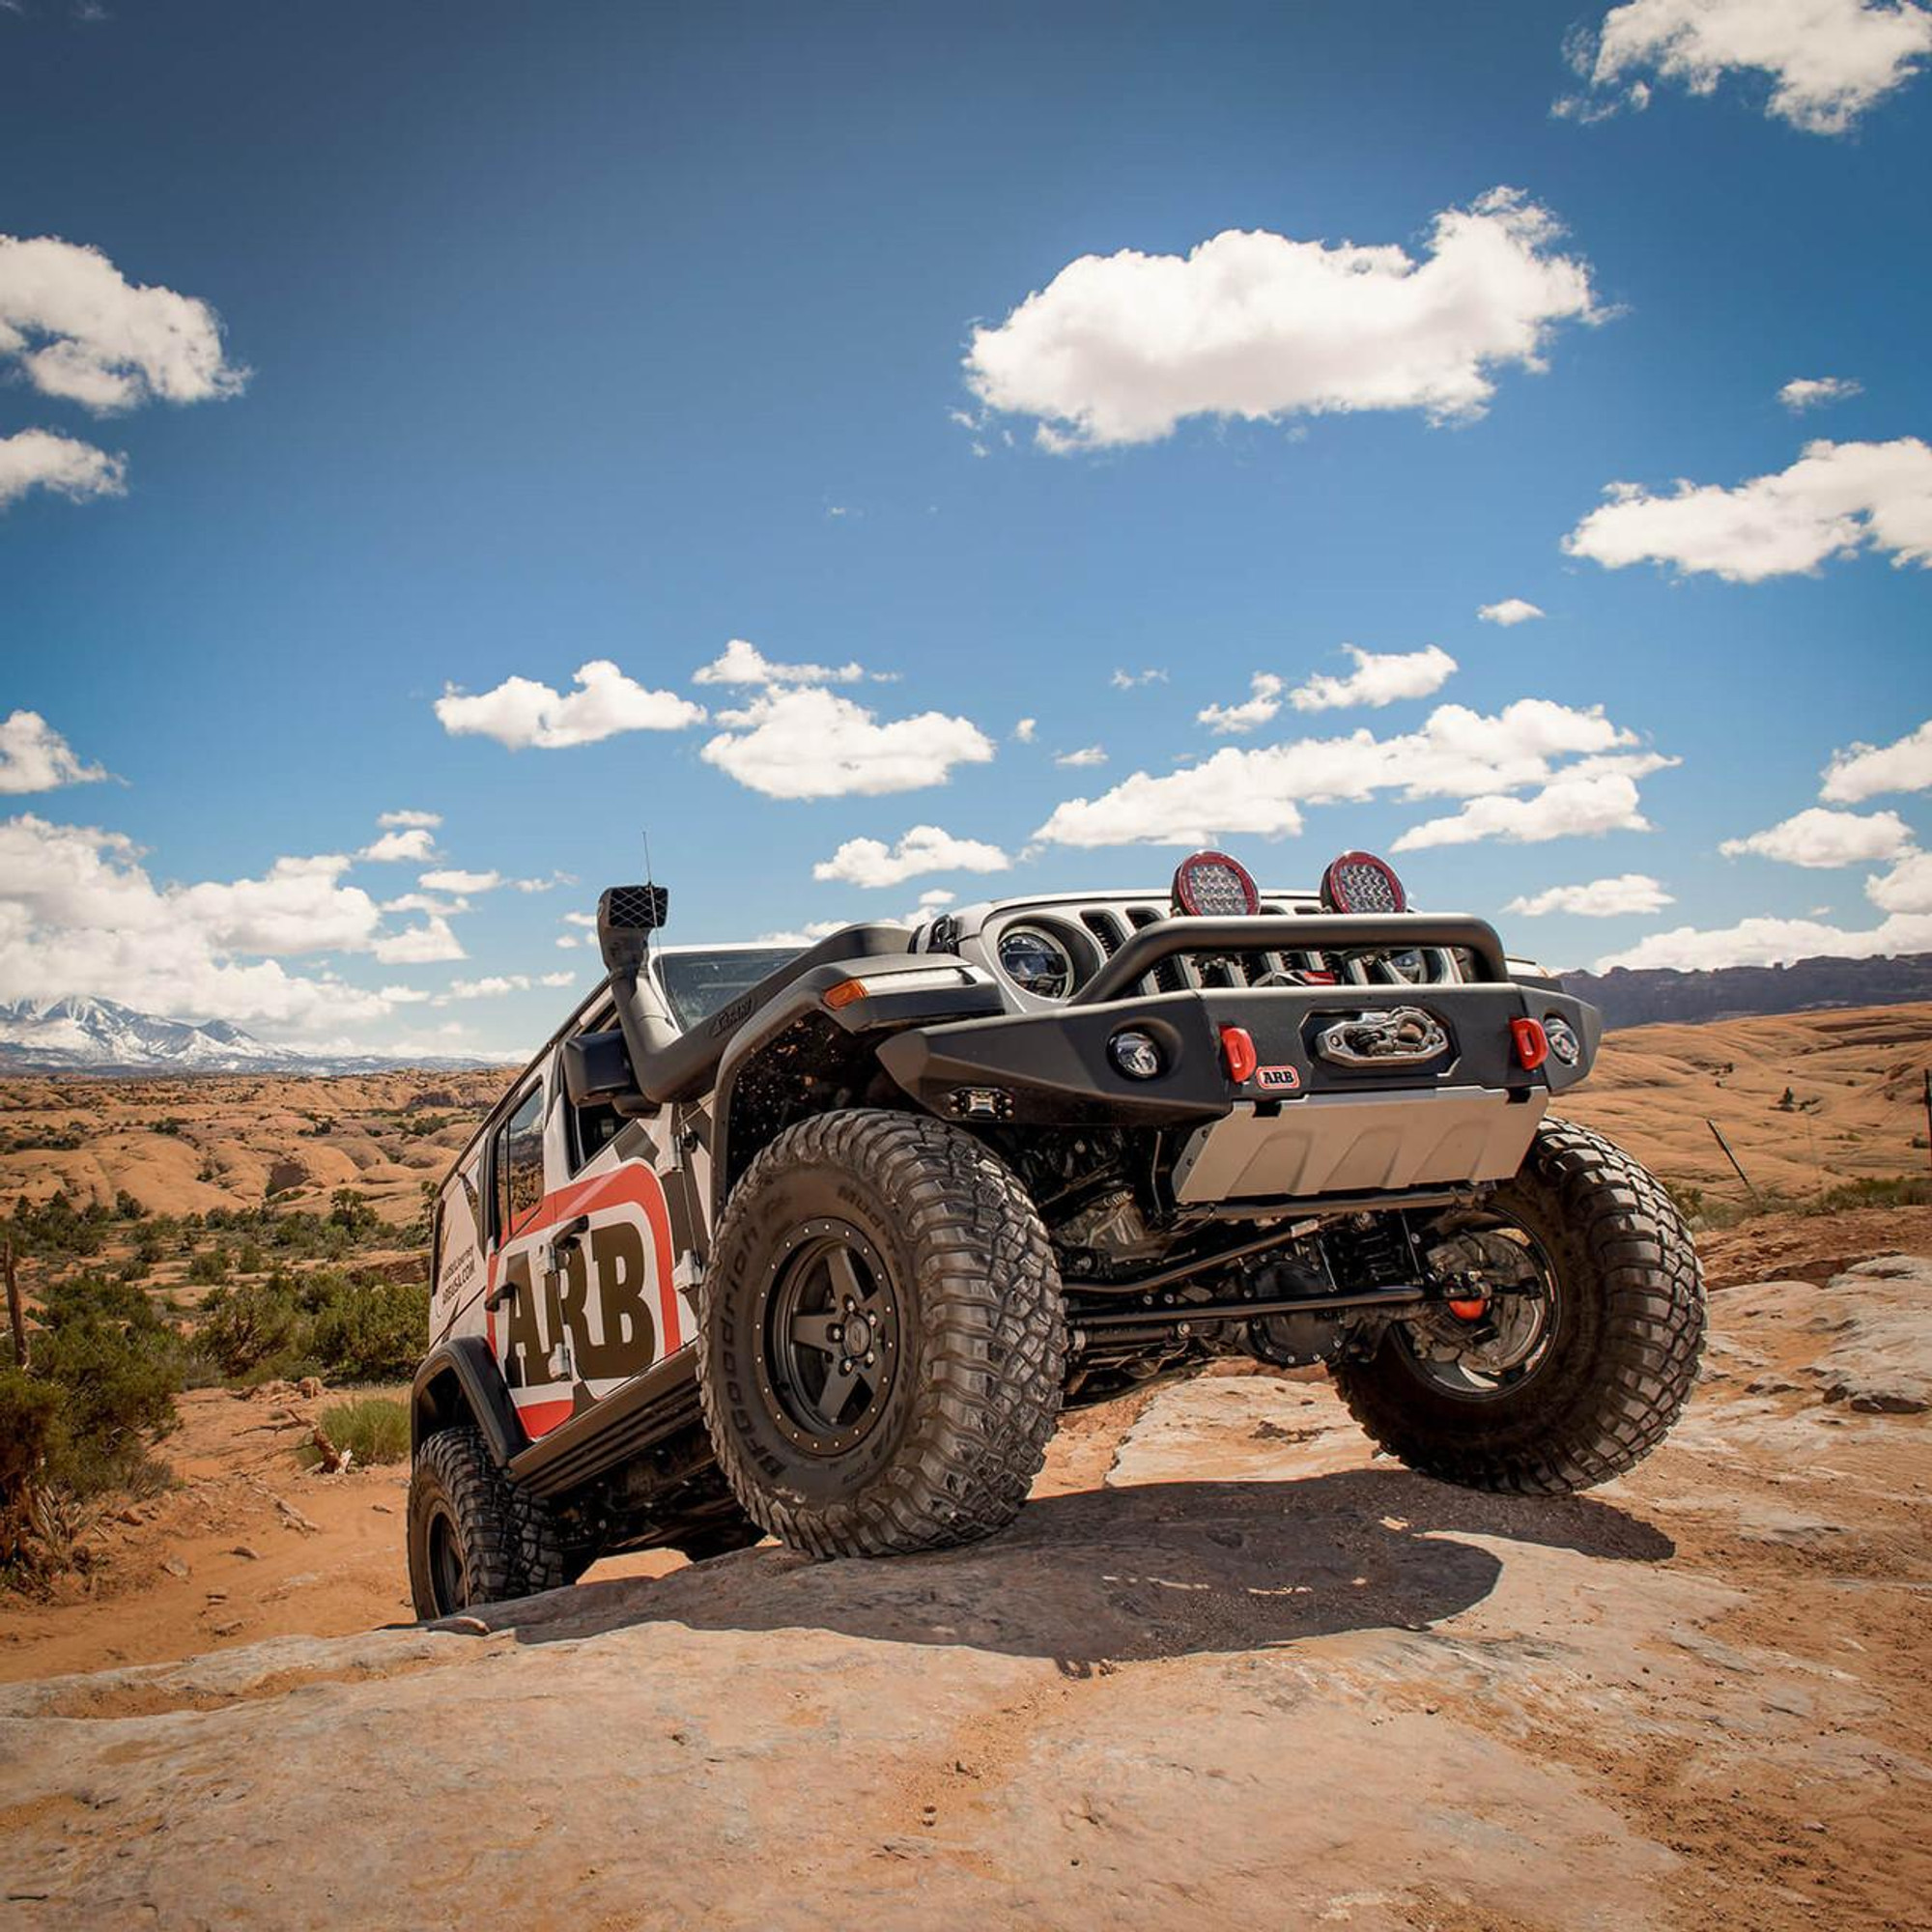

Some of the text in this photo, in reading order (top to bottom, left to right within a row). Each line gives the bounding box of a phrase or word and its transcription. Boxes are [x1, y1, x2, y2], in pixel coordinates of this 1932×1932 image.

[1263, 1070, 1294, 1084] ARB
[504, 1222, 656, 1388] ARB
[720, 1224, 787, 1480] BFGoodrich
